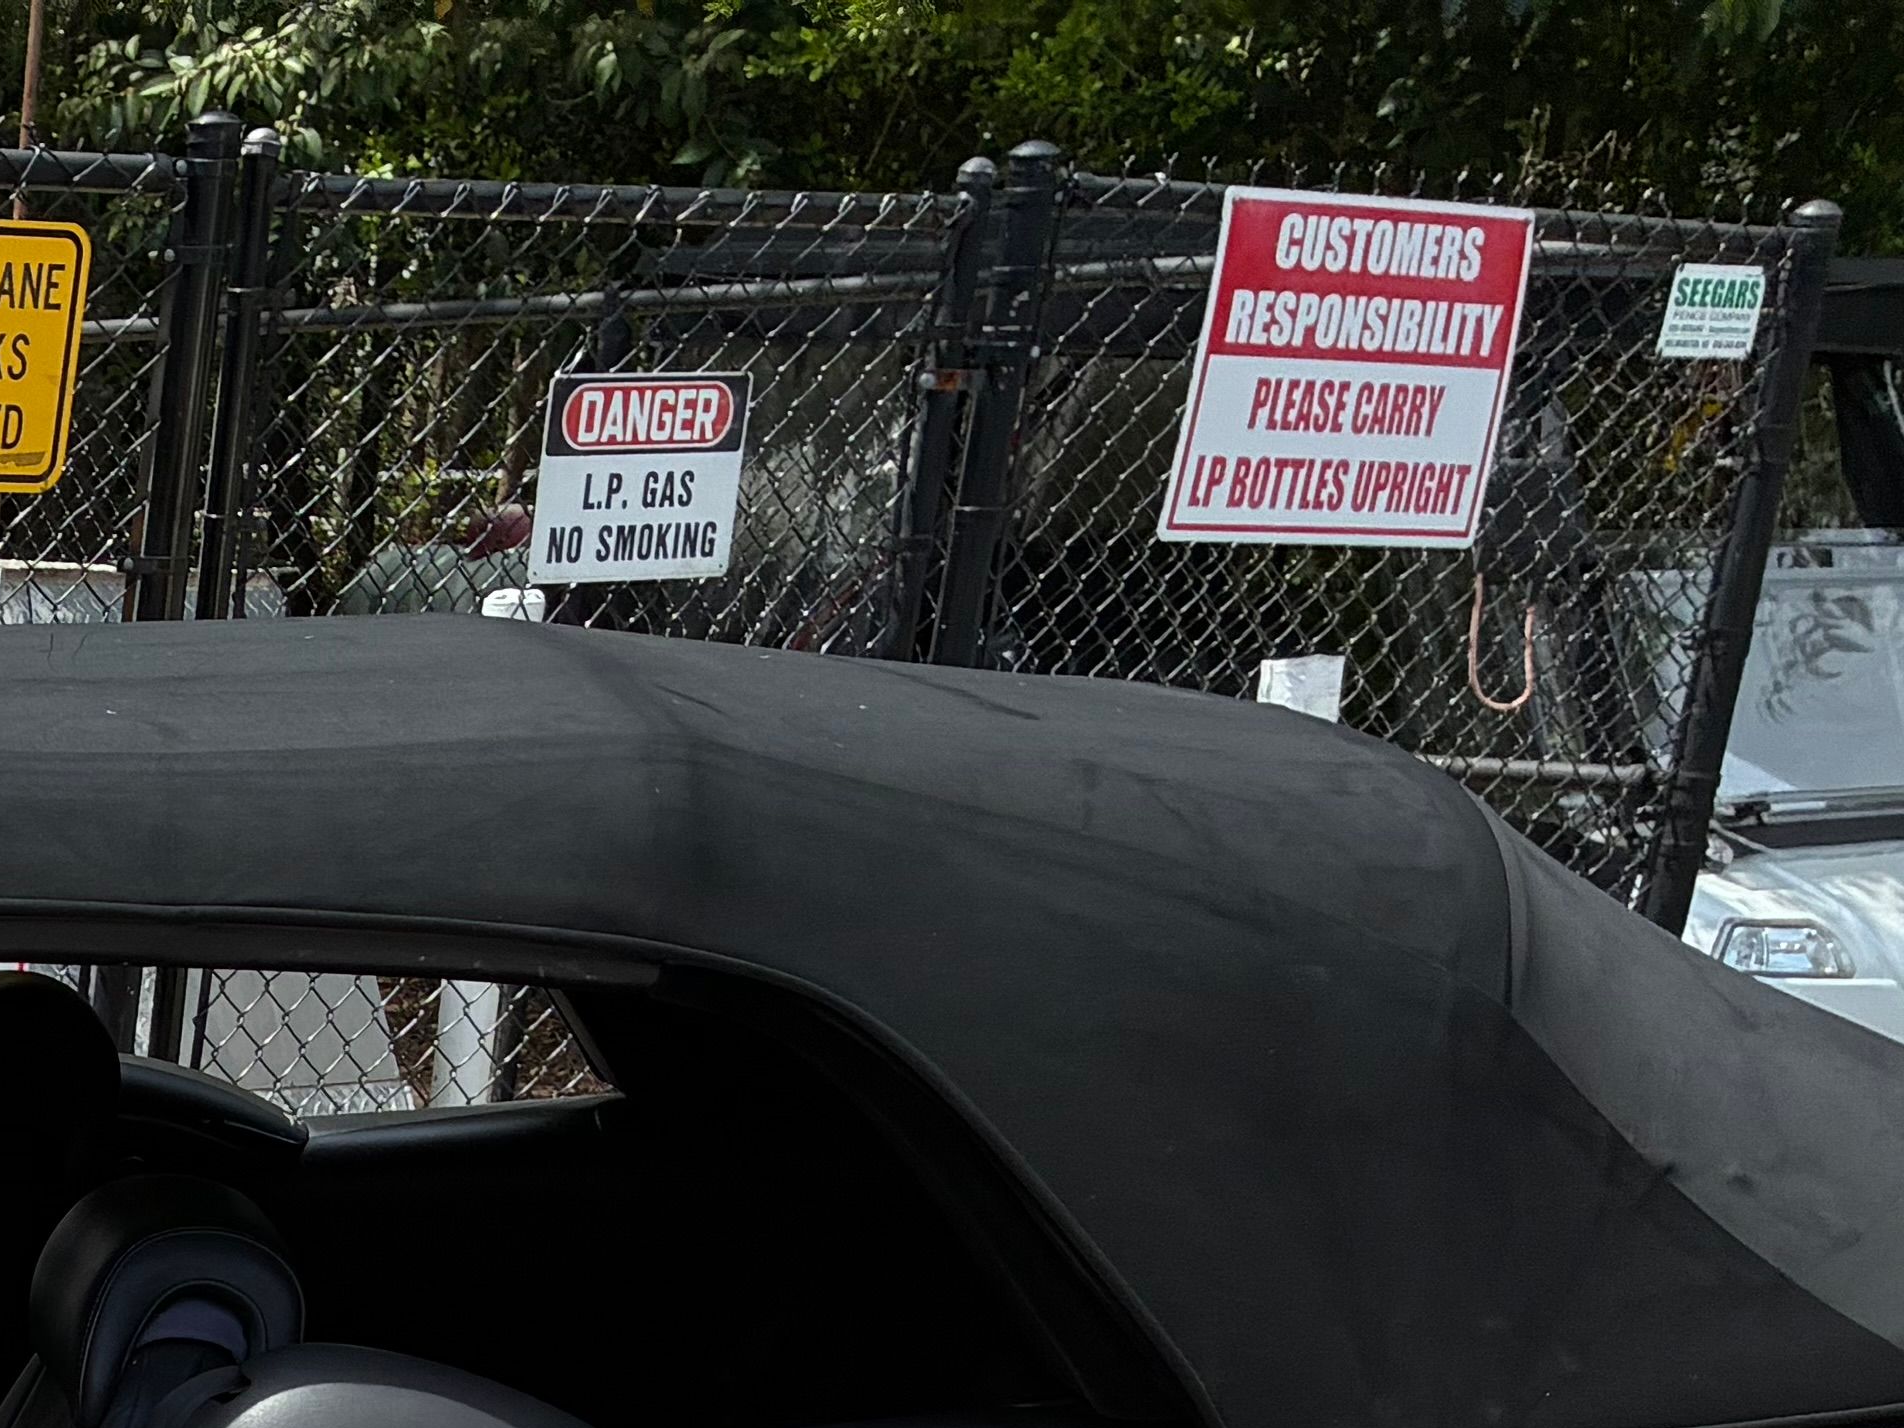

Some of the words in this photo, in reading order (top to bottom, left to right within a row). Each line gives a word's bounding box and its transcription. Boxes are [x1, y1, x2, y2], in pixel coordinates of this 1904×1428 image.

[1275, 213, 1485, 281] CUSTOMERS
[1674, 277, 1761, 309] SEEGARS
[1224, 289, 1504, 357] RESPONSIBILITY
[577, 388, 719, 443] DANGER
[1247, 377, 1351, 432] PLEASE
[1350, 381, 1446, 437] CARRY
[582, 473, 628, 510] L.P.
[641, 470, 695, 509] GAS
[1188, 455, 1227, 508] LP
[1225, 456, 1349, 511] BOTTLES
[1350, 460, 1472, 515] UPRIGHT
[546, 525, 583, 564] NO
[595, 521, 717, 562] SMOKING
